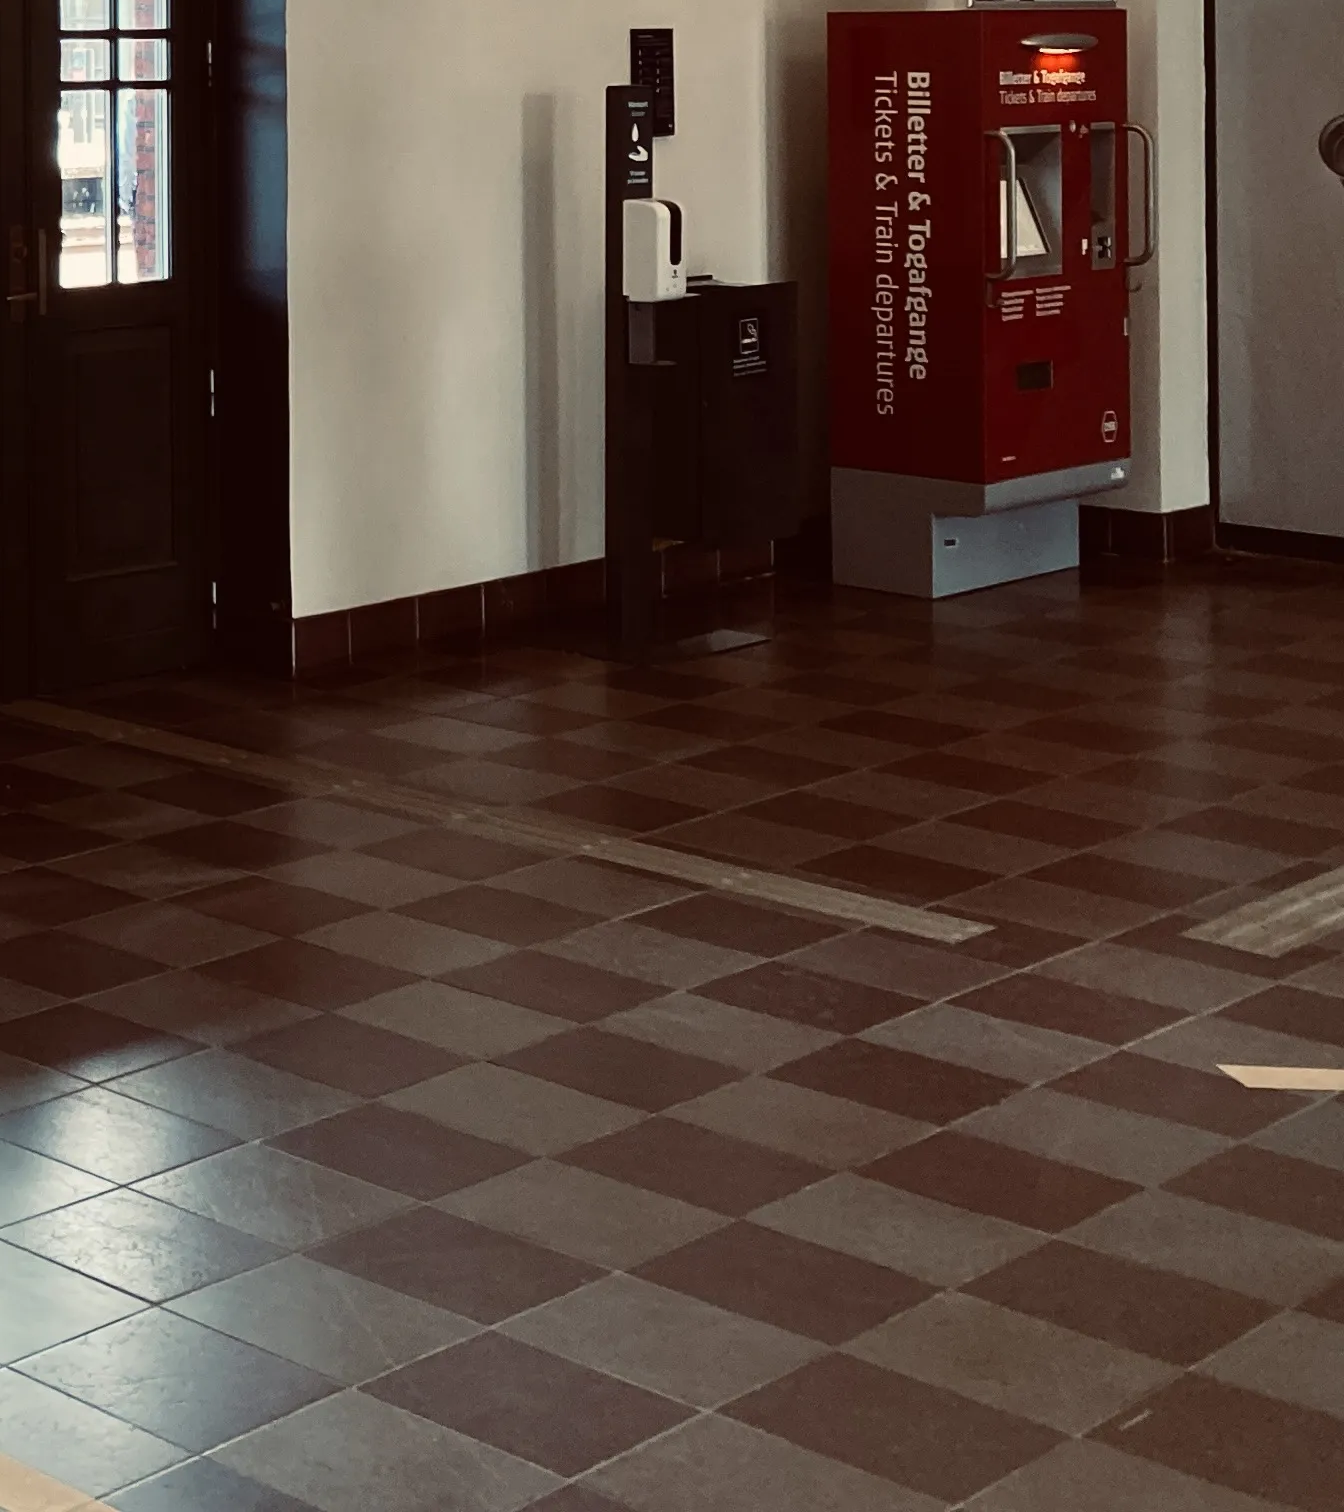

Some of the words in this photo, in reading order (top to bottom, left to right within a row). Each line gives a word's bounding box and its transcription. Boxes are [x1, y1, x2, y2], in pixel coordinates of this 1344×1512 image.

[874, 70, 898, 163] Tickets
[907, 71, 931, 183] Billetter
[875, 173, 898, 191] &
[908, 191, 931, 211] &
[875, 200, 899, 263] Train
[870, 273, 899, 415] departures
[904, 219, 932, 380] Togafgange
